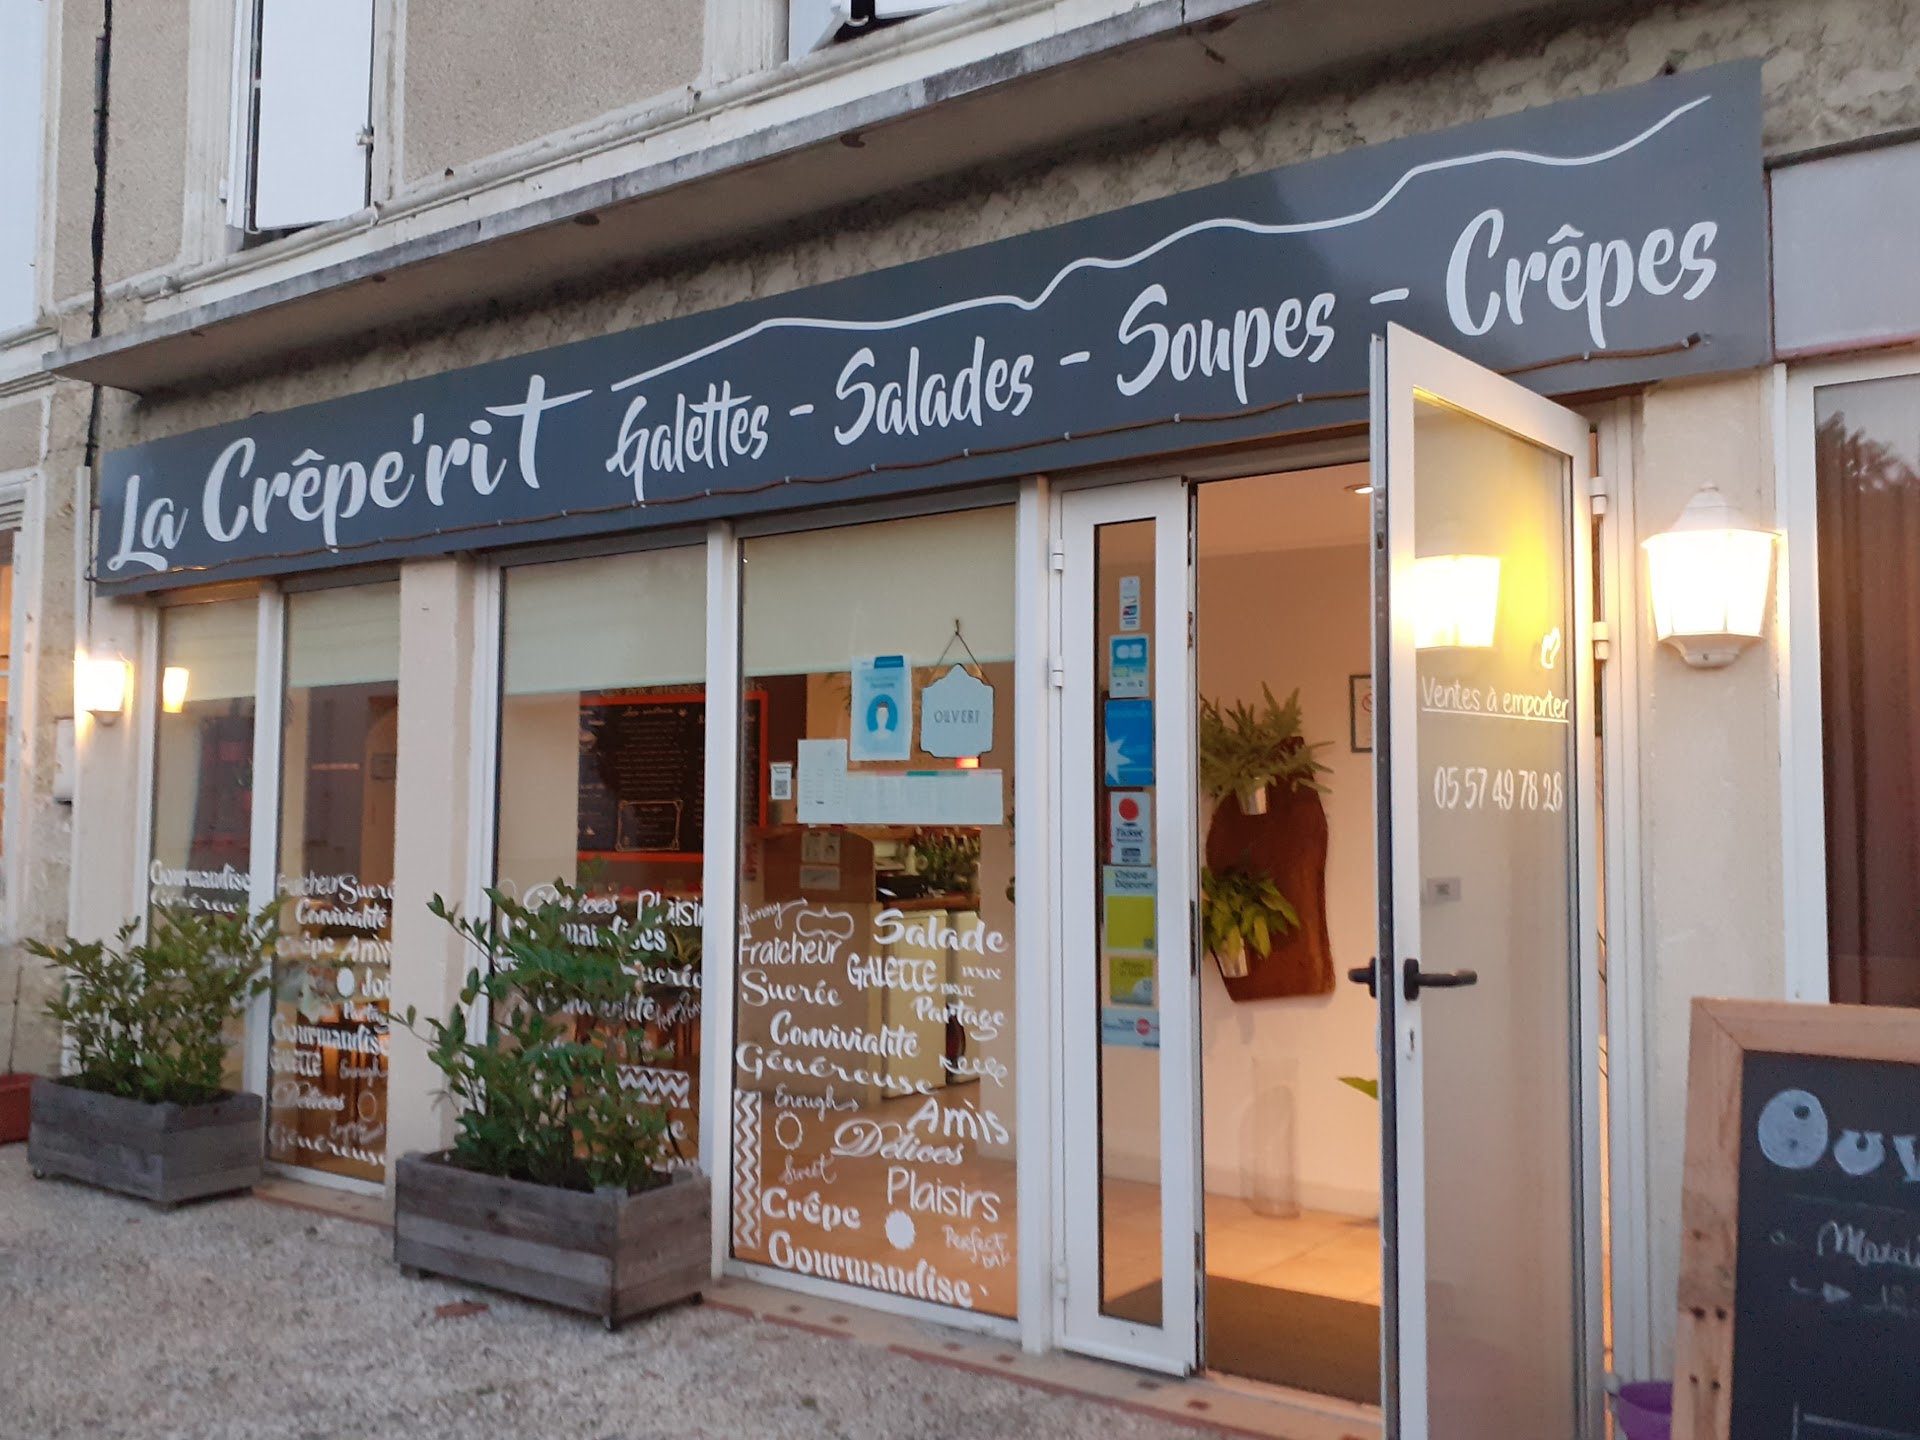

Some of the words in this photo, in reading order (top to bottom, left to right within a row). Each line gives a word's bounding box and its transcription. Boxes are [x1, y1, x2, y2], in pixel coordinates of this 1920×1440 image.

[606, 380, 768, 507] Galettes
[834, 336, 1034, 445] Salades
[1117, 284, 1335, 404] Soupes
[1445, 208, 1718, 349] Crêpes
[107, 474, 189, 571] La
[933, 709, 980, 724] OUVERT
[1421, 675, 1481, 711] Ventes
[1487, 686, 1499, 713] à
[1502, 690, 1569, 720] emporter
[1434, 766, 1460, 809] 05
[1464, 767, 1488, 810] 57
[1492, 768, 1515, 811] 49
[1518, 769, 1539, 811] 78
[873, 908, 1008, 955] Salade
[847, 952, 938, 992] GALETTE
[911, 995, 1008, 1042] Partage
[906, 1097, 1009, 1145] Amis
[761, 1187, 861, 1232] Crêpe
[887, 1166, 1001, 1223] Plaisirs
[768, 1230, 974, 1308] Gourmandise
